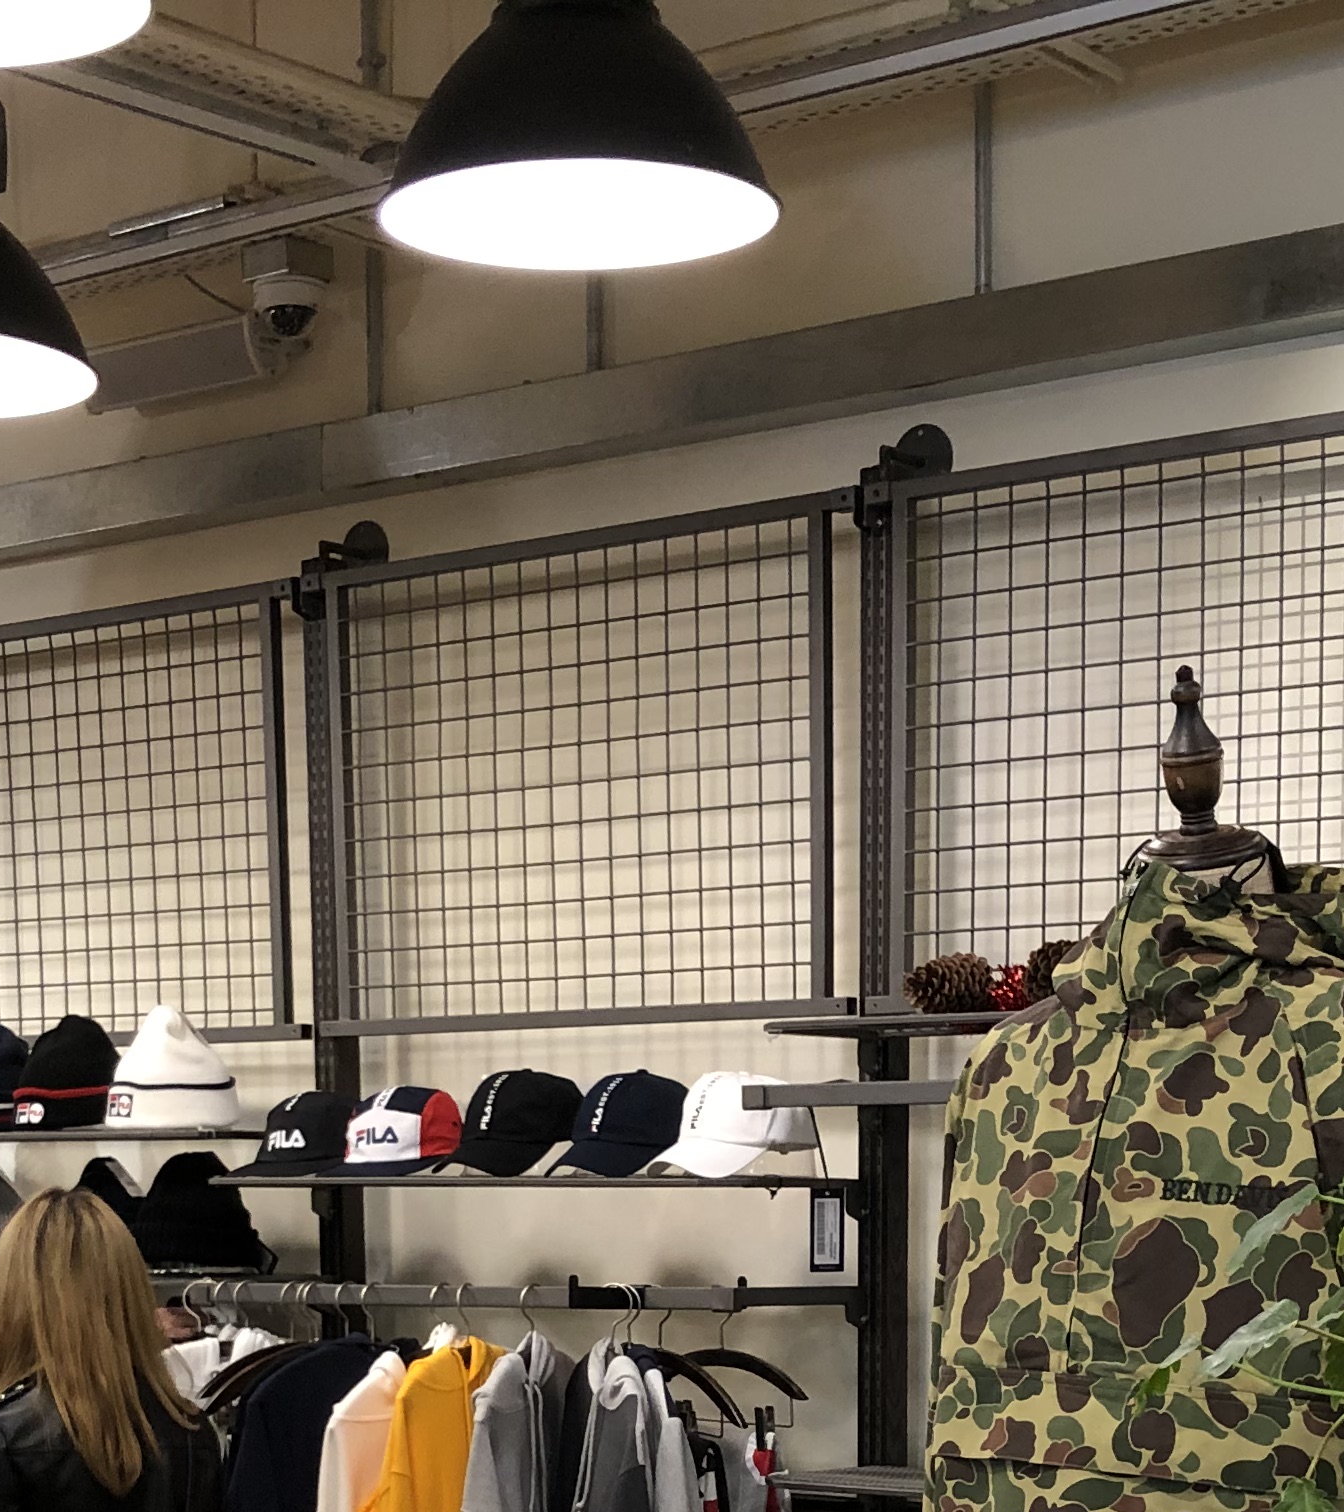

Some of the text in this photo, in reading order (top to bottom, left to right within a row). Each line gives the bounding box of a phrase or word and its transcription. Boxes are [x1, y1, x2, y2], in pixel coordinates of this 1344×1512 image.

[480, 1105, 493, 1131] FILA
[590, 1107, 604, 1133] FILA
[268, 1129, 306, 1152] FILA
[356, 1126, 399, 1149] FILA
